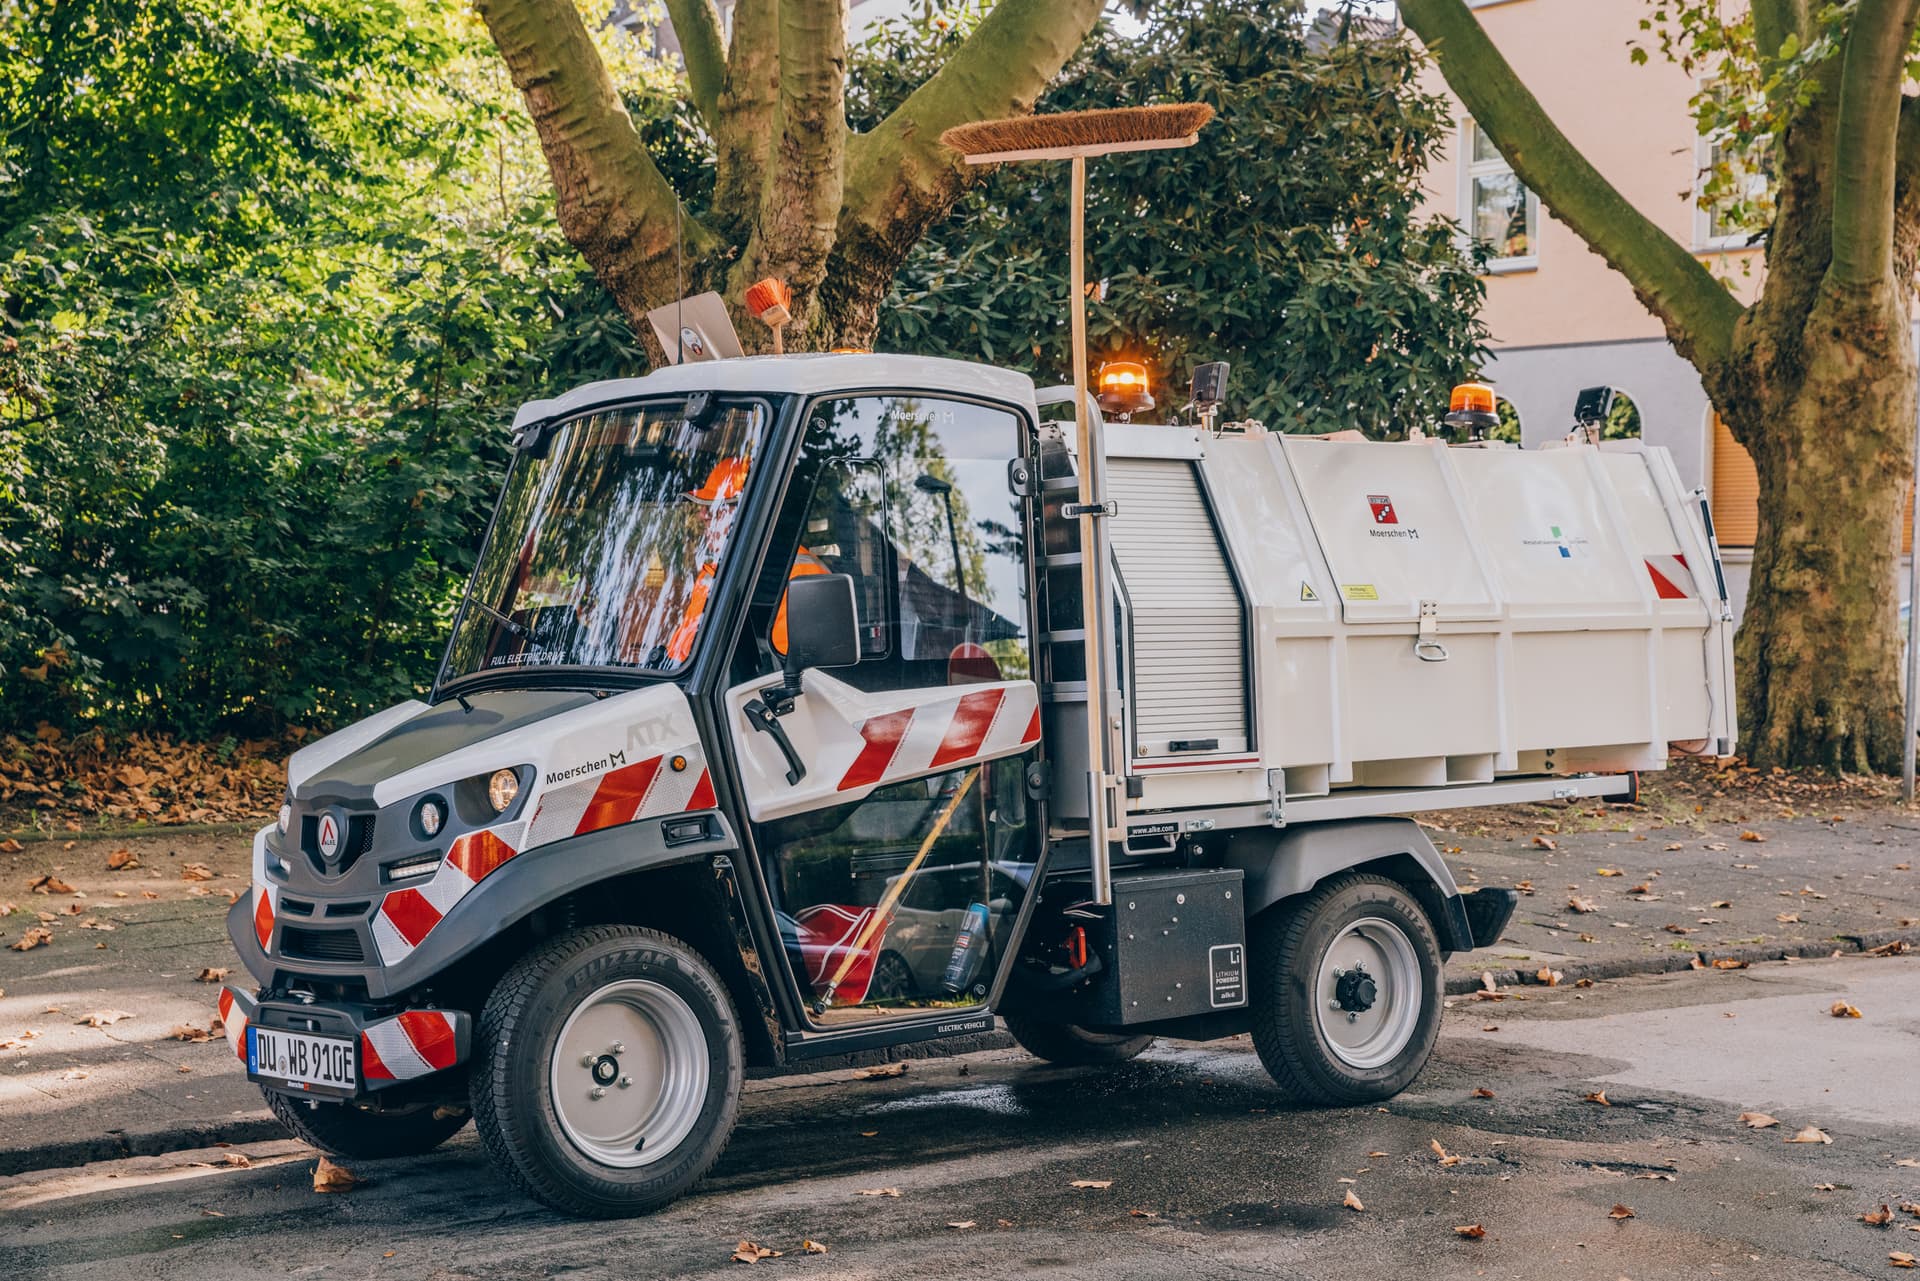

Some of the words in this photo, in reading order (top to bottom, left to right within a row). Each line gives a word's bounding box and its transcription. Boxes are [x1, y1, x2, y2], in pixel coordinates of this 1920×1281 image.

[1369, 529, 1408, 537] Moerschen
[490, 655, 506, 666] FULL
[626, 712, 680, 752] ATX
[546, 758, 608, 785] Moerschen
[1230, 949, 1240, 964] Li
[574, 950, 672, 985] BLIZZAK
[1215, 970, 1239, 978] LITHIUM
[938, 1022, 963, 1033] ELECTRIC
[963, 1020, 986, 1030] VEHICLE
[257, 1033, 277, 1072] DU
[288, 1038, 308, 1077] WB
[312, 1042, 355, 1084] 910E
